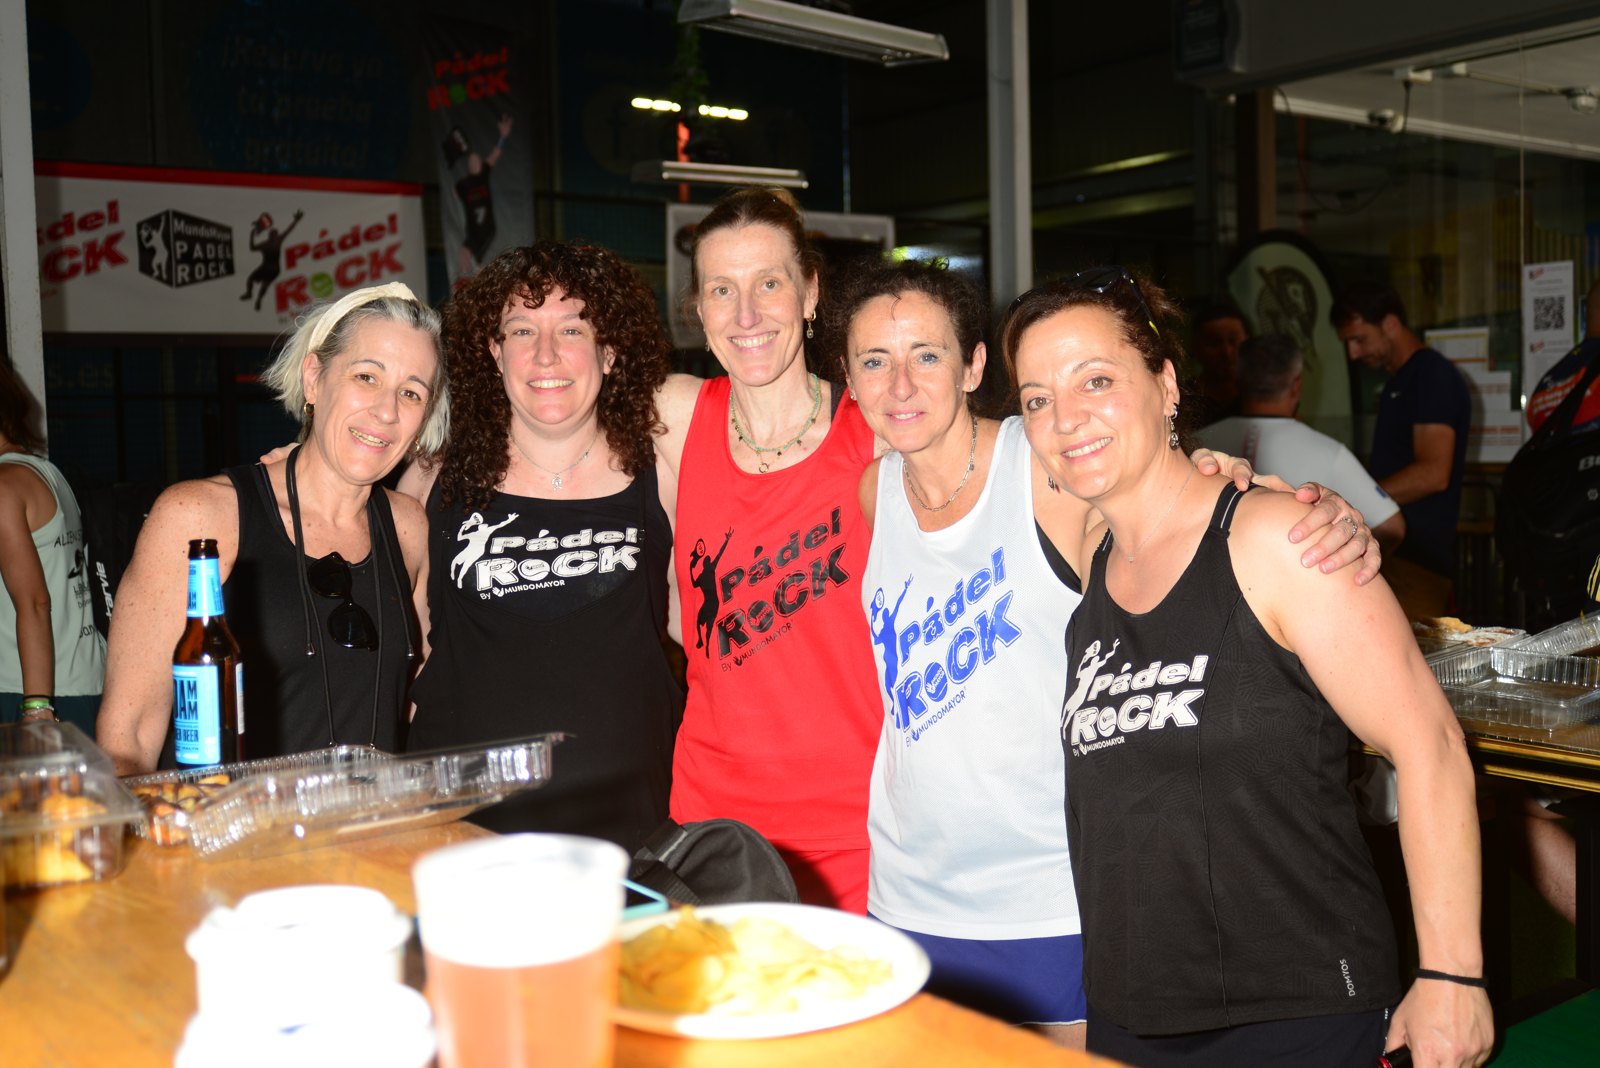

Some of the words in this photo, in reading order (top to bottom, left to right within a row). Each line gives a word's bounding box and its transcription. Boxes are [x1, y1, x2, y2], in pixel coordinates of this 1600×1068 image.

[175, 240, 233, 260] PADEL
[284, 212, 398, 270] Pádel
[177, 262, 227, 284] ROCK
[490, 528, 638, 554] Pádel
[719, 506, 842, 605] Pádel
[96, 561, 114, 623] tarvie
[480, 592, 491, 600] By
[504, 579, 565, 594] MUNDOMAYOR
[899, 546, 1007, 667] Pádel
[721, 662, 733, 672] By
[742, 622, 793, 661] MUNDOMAYOR
[1087, 655, 1209, 701] Pádel
[918, 690, 966, 735] MUNDOMAYOR
[1085, 736, 1126, 752] MUNDOMAYOR
[1340, 959, 1356, 997] DOMYOS
